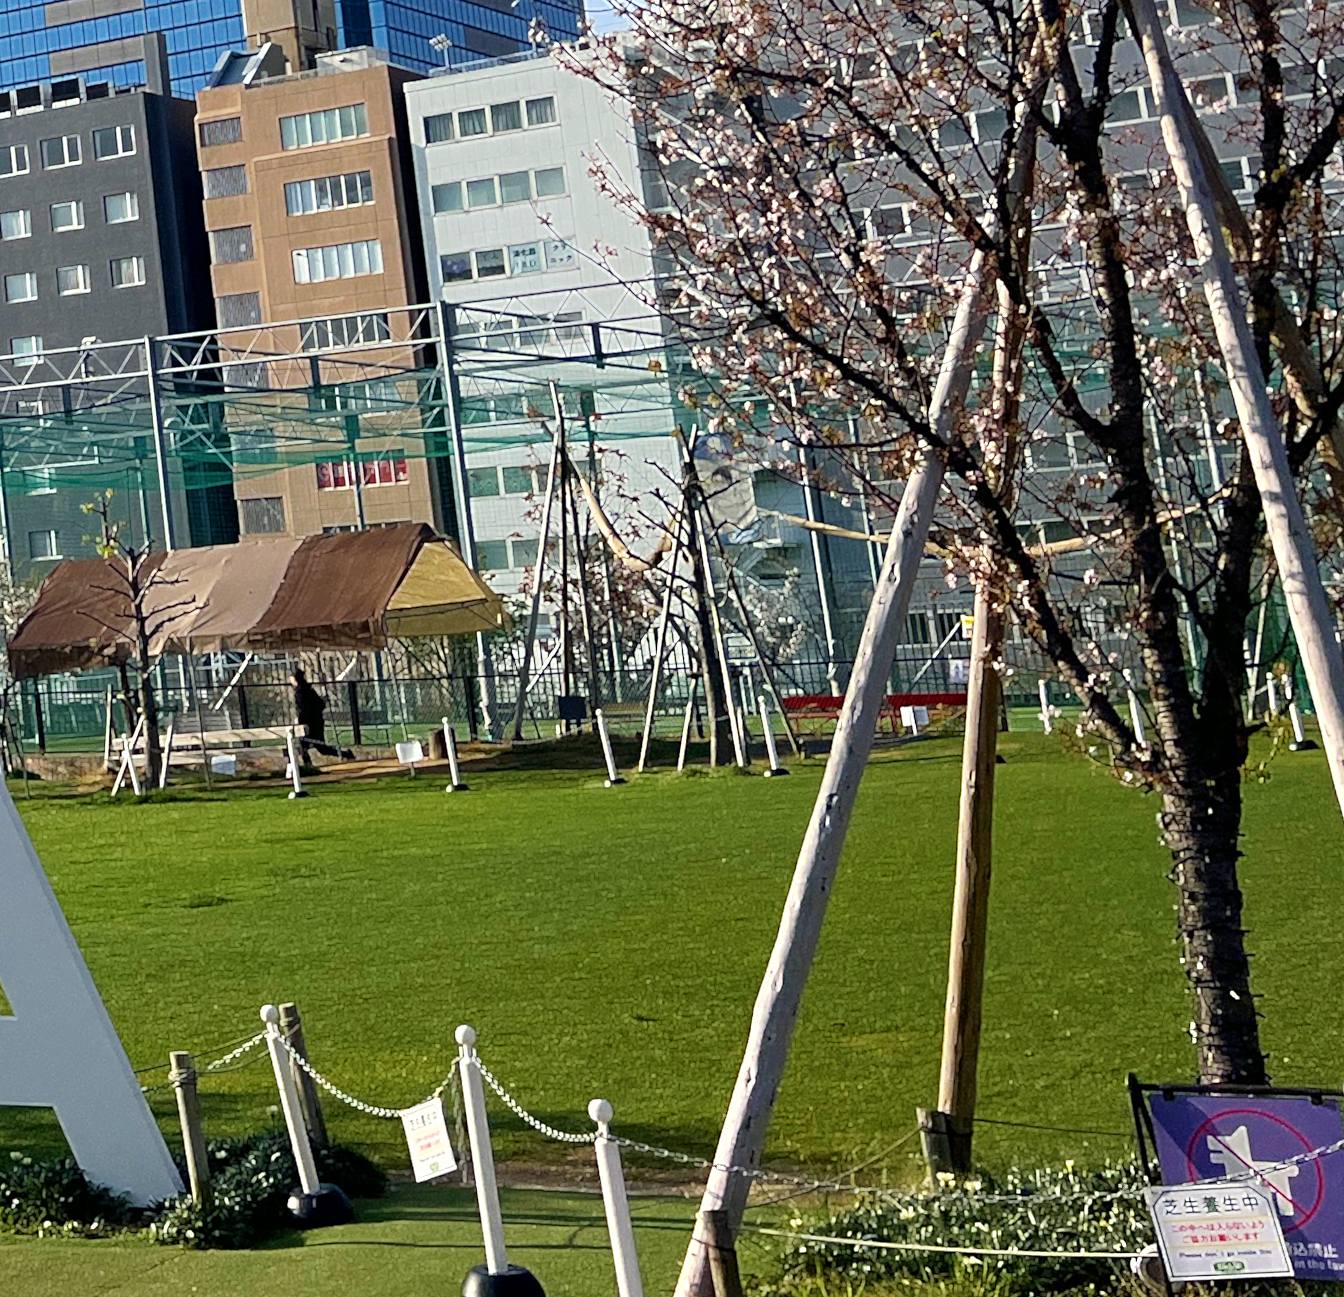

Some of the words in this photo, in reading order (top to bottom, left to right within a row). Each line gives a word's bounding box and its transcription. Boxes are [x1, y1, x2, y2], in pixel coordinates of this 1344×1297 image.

[1163, 1194, 1259, 1216] 芝生養生中
